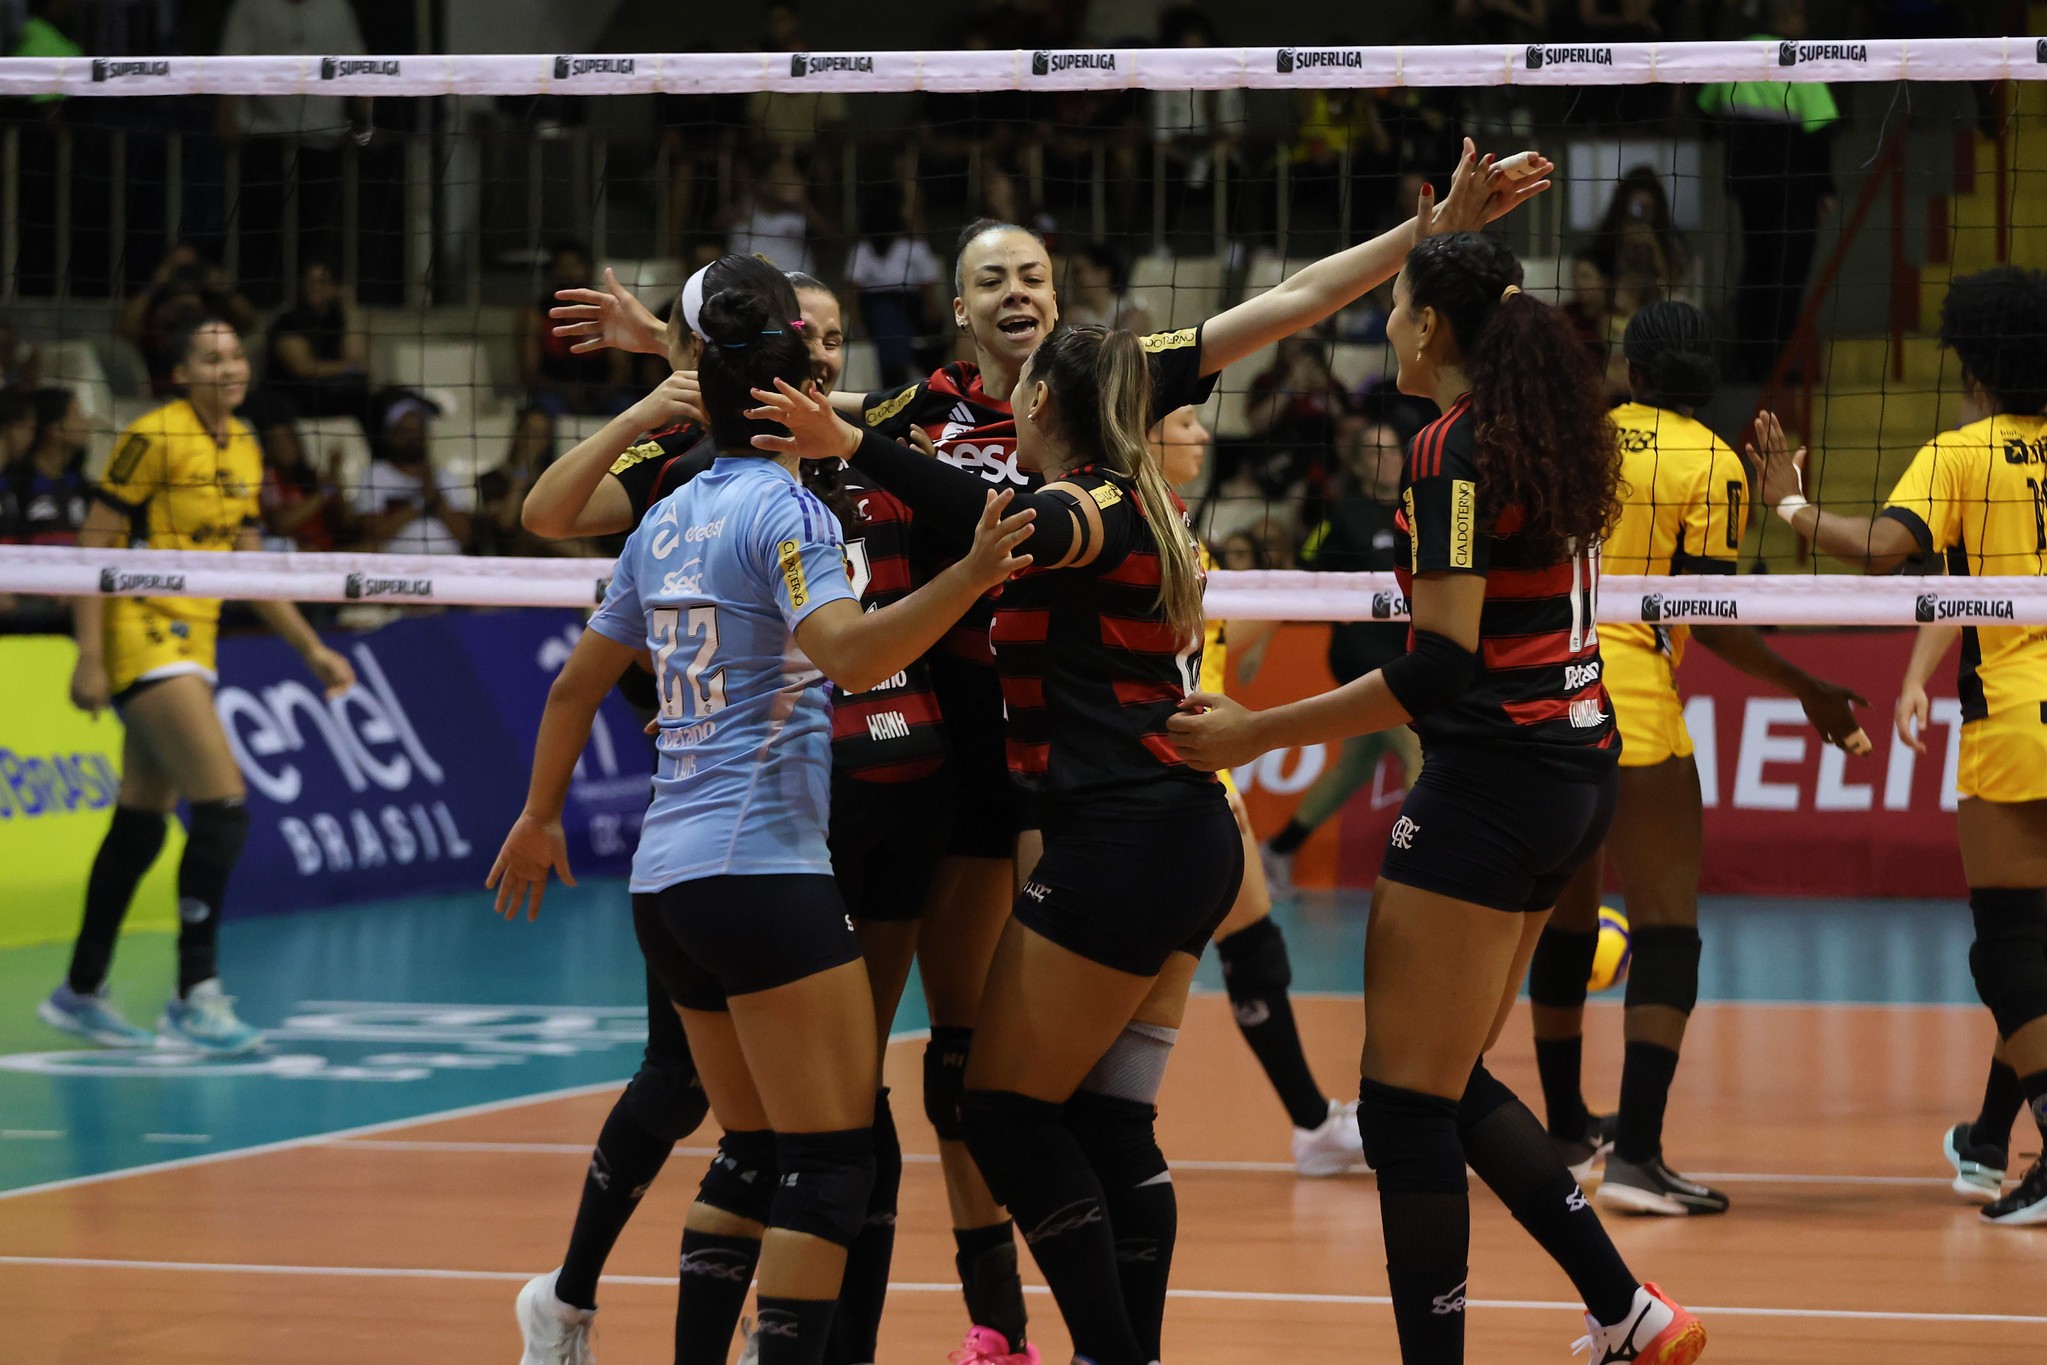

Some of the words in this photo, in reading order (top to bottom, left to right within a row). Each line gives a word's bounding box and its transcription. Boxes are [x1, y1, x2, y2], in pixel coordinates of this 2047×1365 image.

[1052, 53, 1115, 71] SUPERLIGA
[1296, 51, 1362, 69] SUPERLIGA
[1545, 47, 1612, 66] SUPERLIGA
[1799, 44, 1867, 63] SUPERLIGA
[110, 61, 170, 78] SUPERLIGA
[339, 59, 400, 76] SUPERLIGA
[572, 58, 634, 75] SUPERLIGA
[809, 56, 874, 74] SUPERLIGA
[119, 574, 186, 591] SUPERLIGA
[365, 578, 433, 596] SUPERLIGA
[1663, 599, 1738, 619] SUPERLIGA
[1938, 599, 2014, 620] SUPERLIGA
[653, 605, 728, 720] 22
[217, 643, 444, 804] enel
[278, 800, 472, 876] BRASIL
